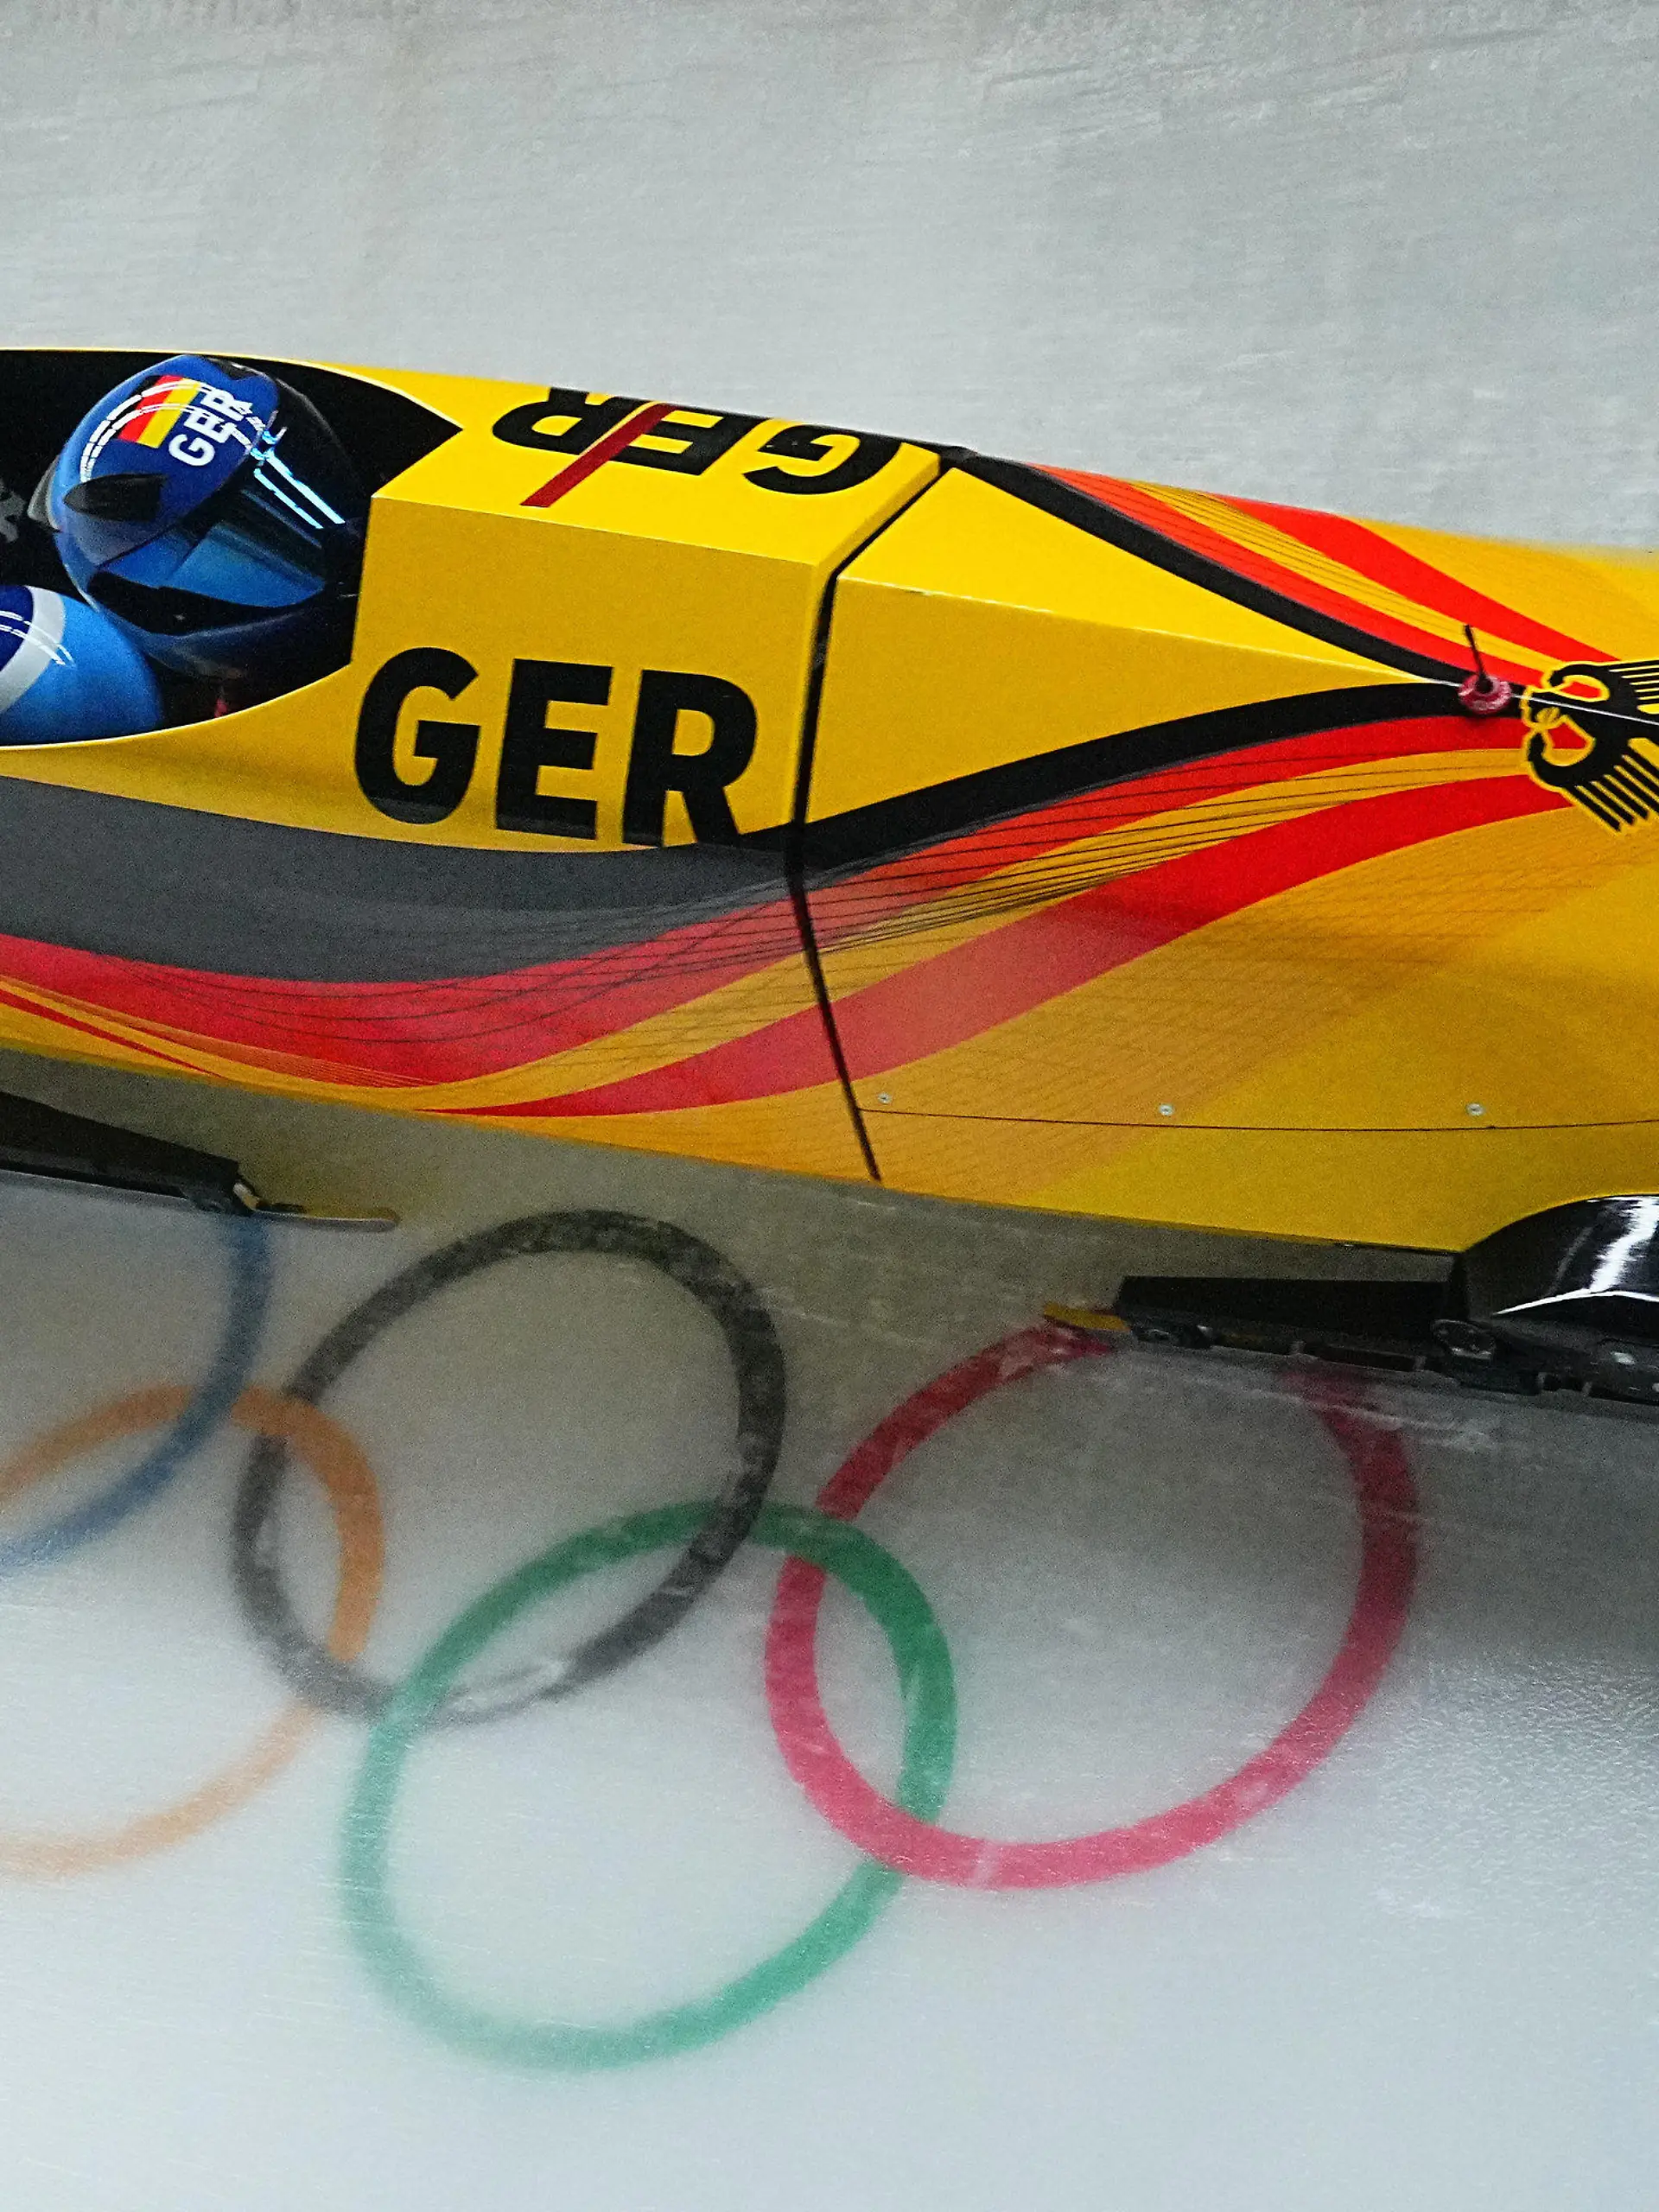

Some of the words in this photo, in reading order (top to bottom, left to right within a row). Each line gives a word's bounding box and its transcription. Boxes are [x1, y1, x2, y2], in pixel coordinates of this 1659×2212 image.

[168, 388, 253, 467] GER
[492, 386, 907, 495] GER
[353, 646, 758, 849] GER
